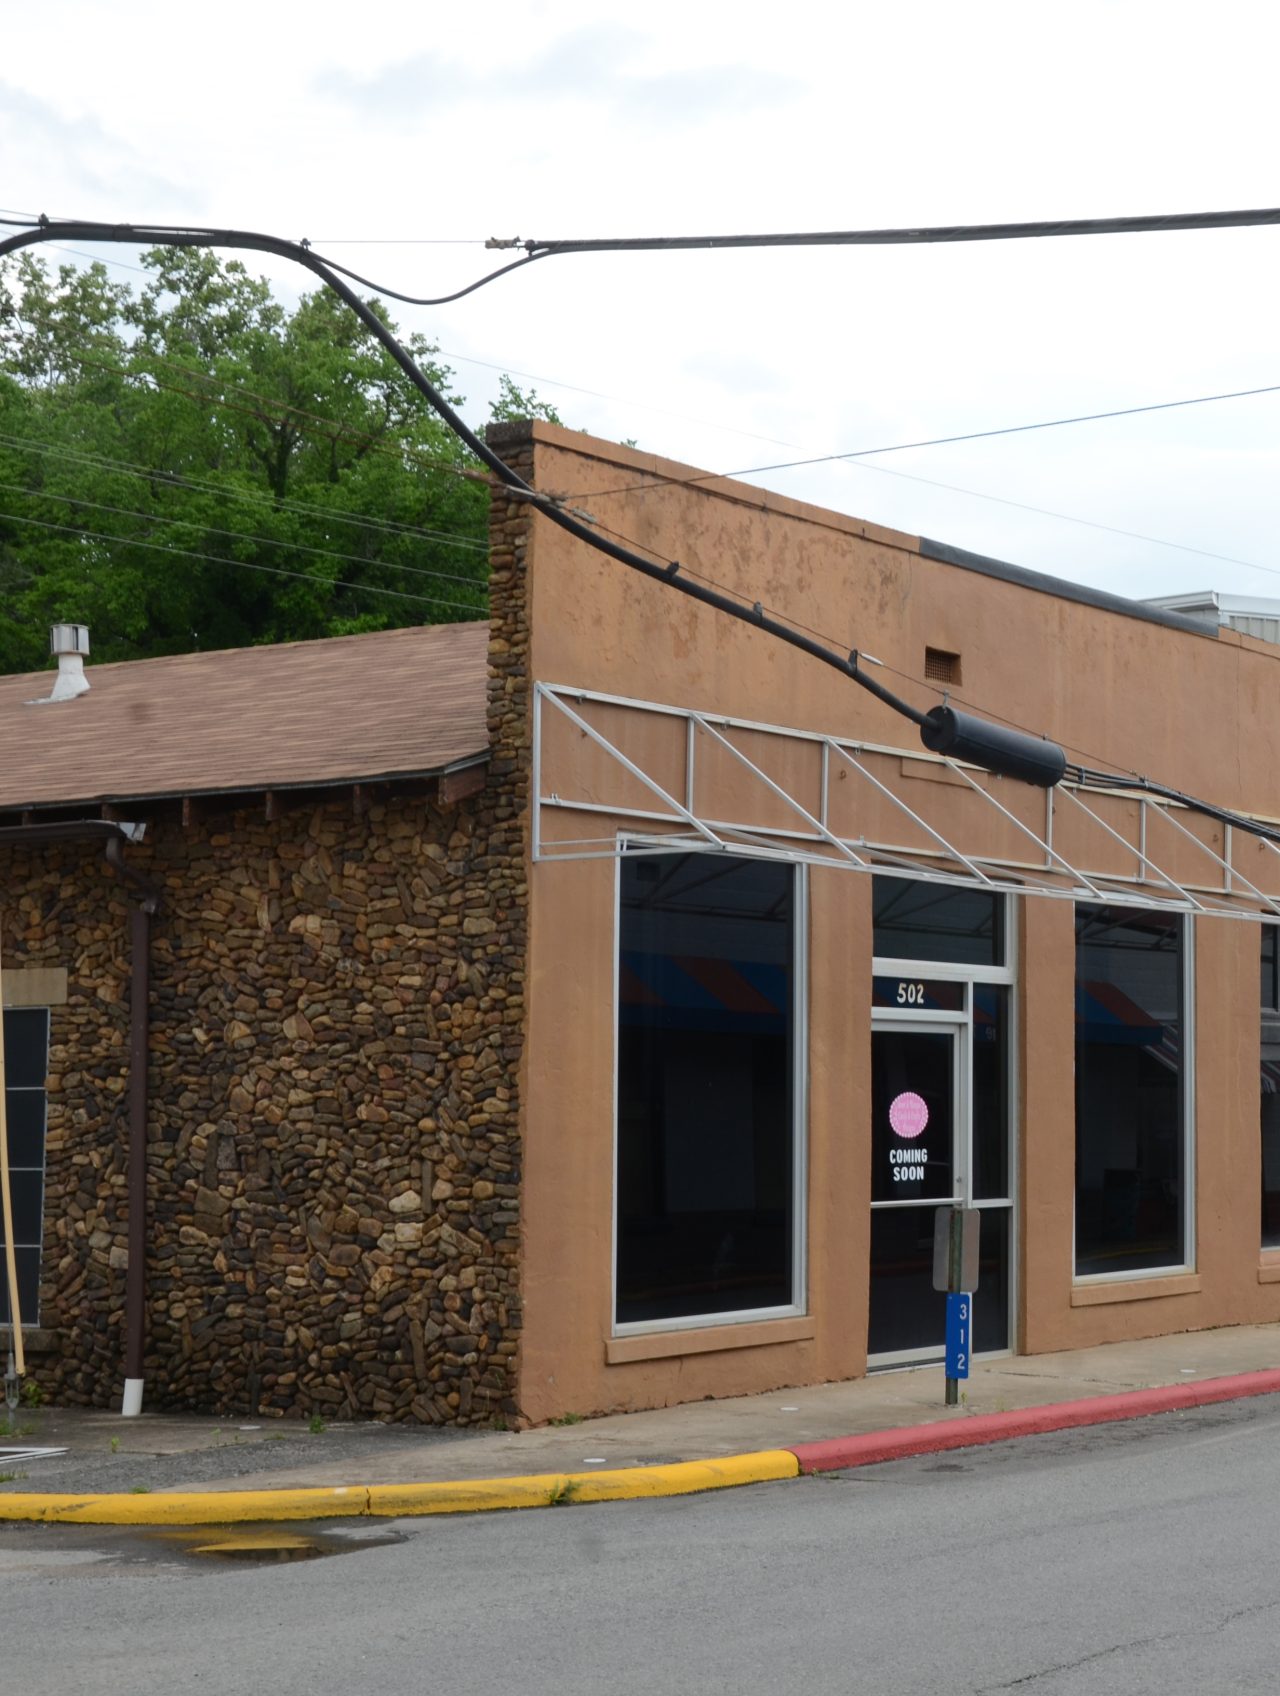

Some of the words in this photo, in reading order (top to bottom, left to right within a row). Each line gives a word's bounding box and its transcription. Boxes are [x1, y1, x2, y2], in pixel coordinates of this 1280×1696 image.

[896, 983, 924, 1004] 502
[889, 1148, 928, 1164] COMING
[893, 1166, 925, 1181] SOON
